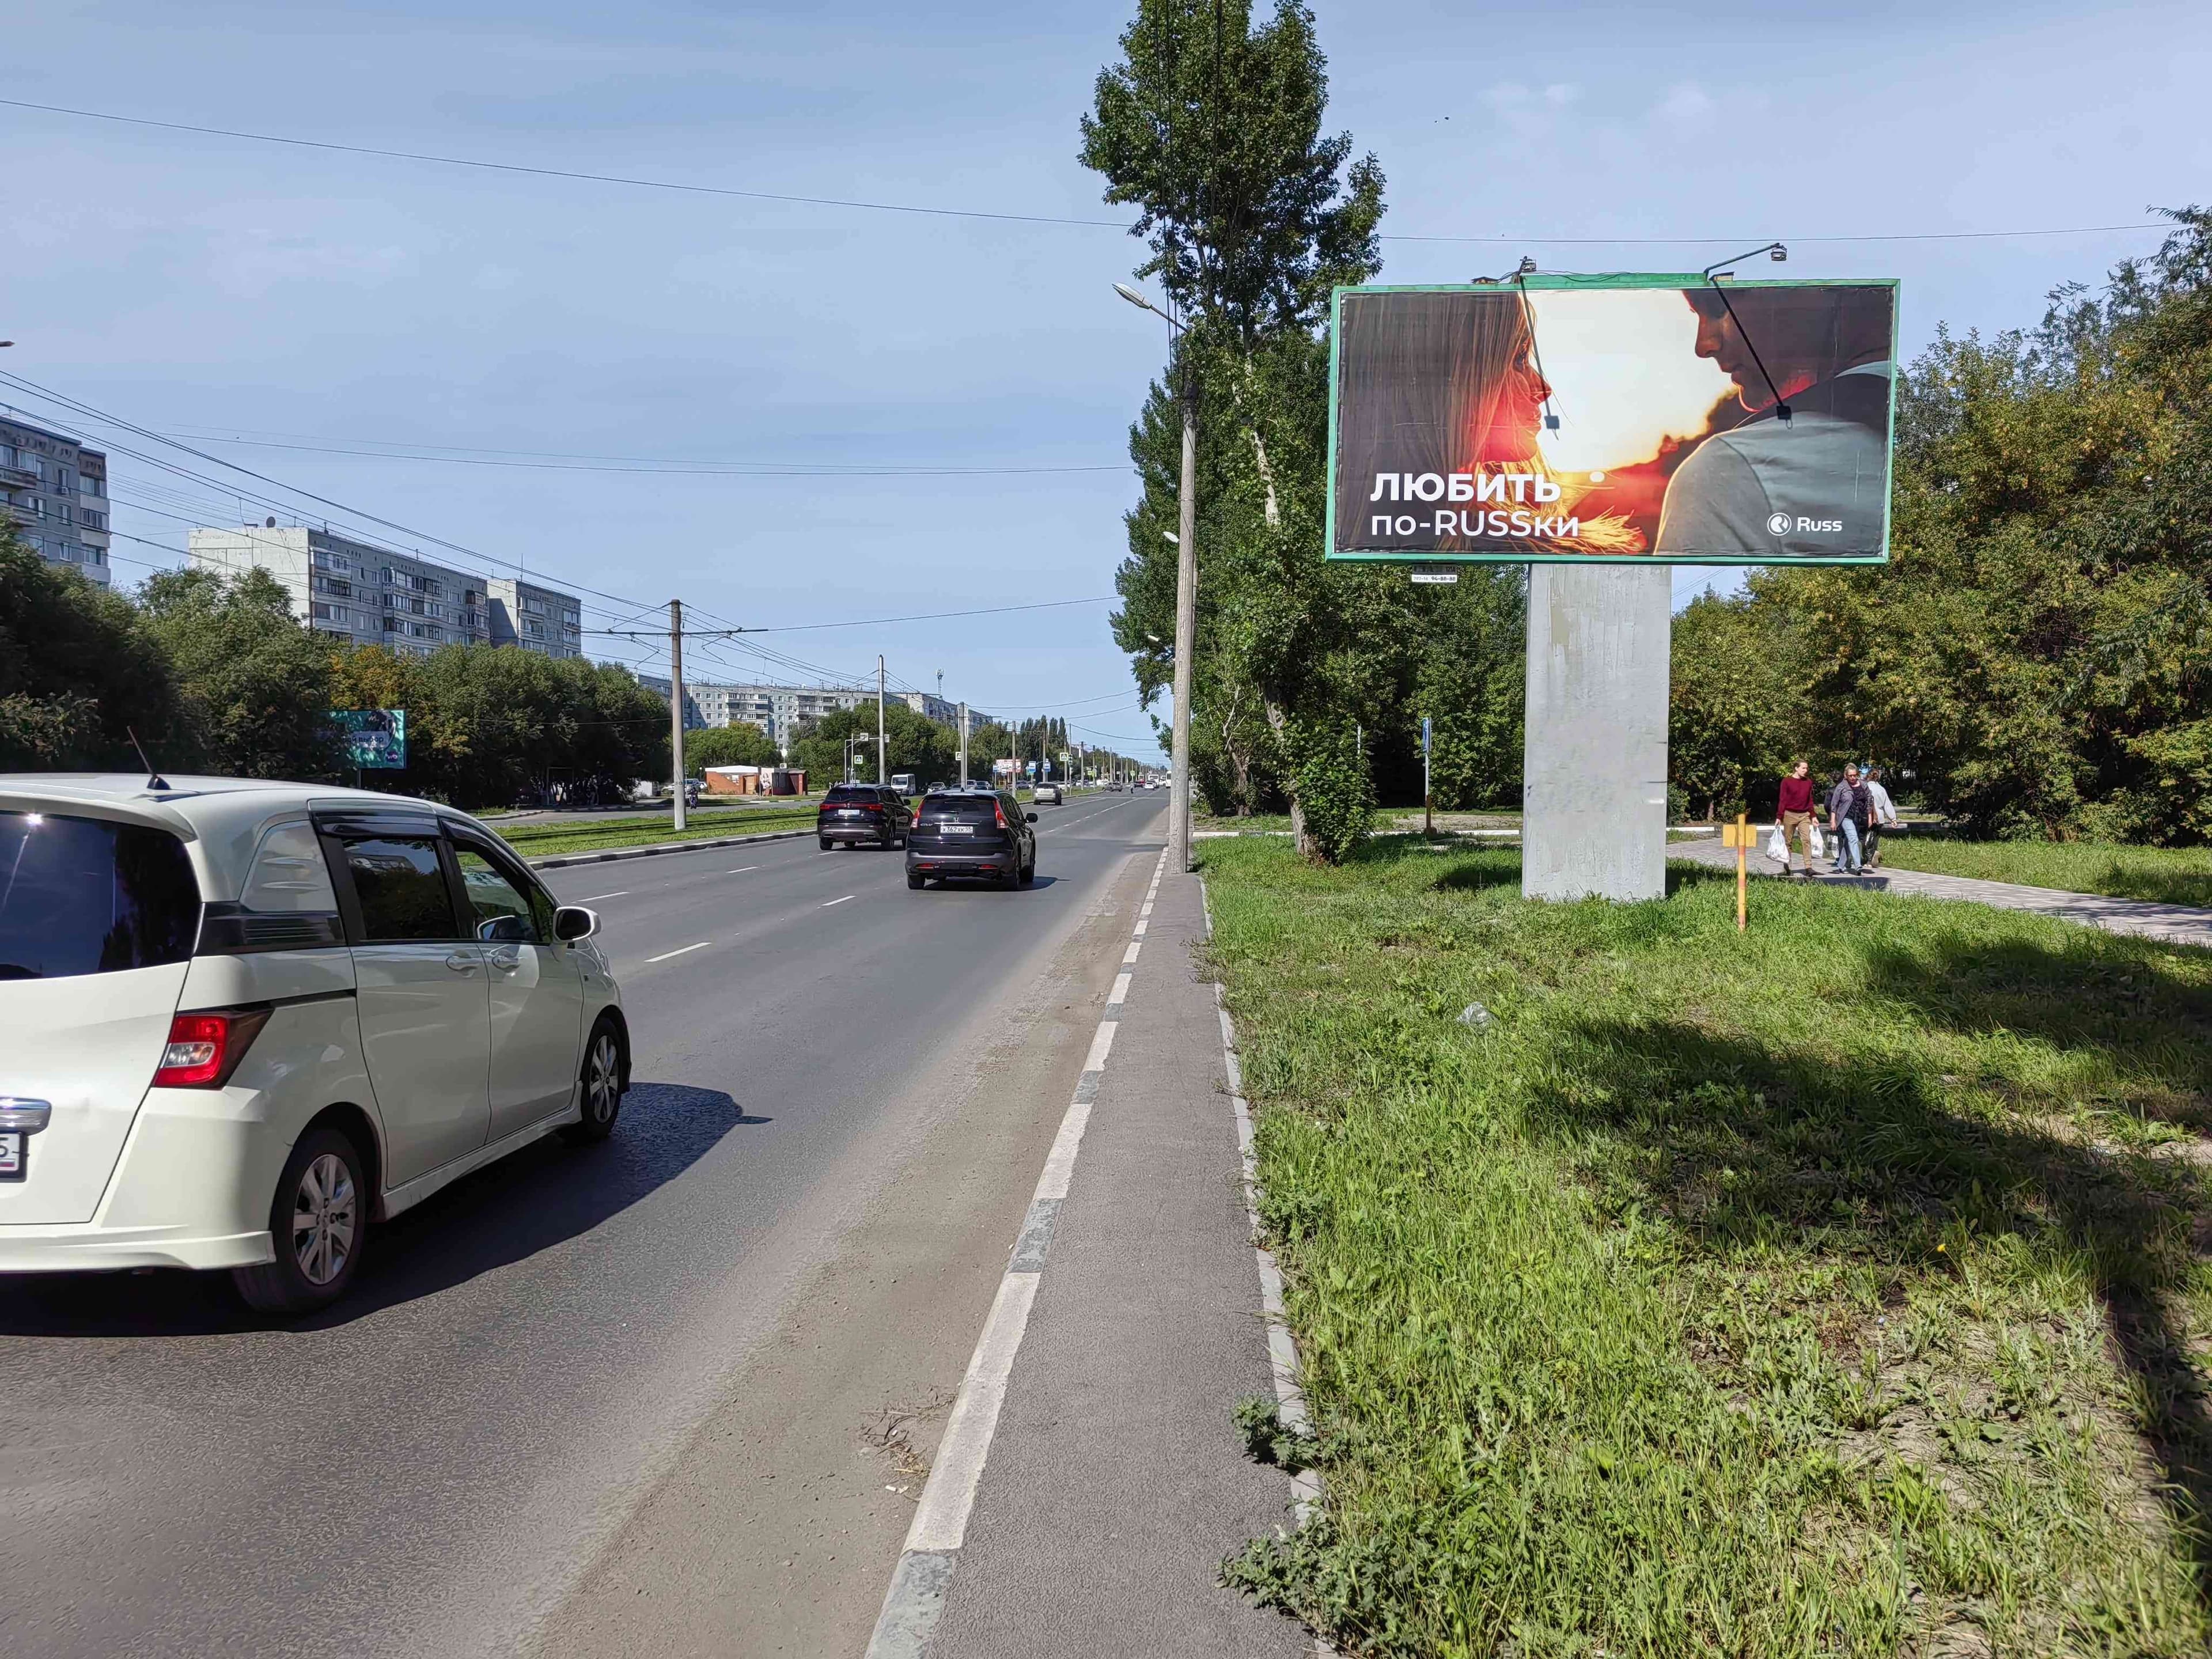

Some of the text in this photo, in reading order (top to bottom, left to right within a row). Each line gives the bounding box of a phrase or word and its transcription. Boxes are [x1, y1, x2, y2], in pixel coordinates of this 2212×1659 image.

[1370, 472, 1561, 502] ЛЮБИТЬ
[1372, 510, 1579, 537] по-RUSSки
[1797, 517, 1843, 532] Russ
